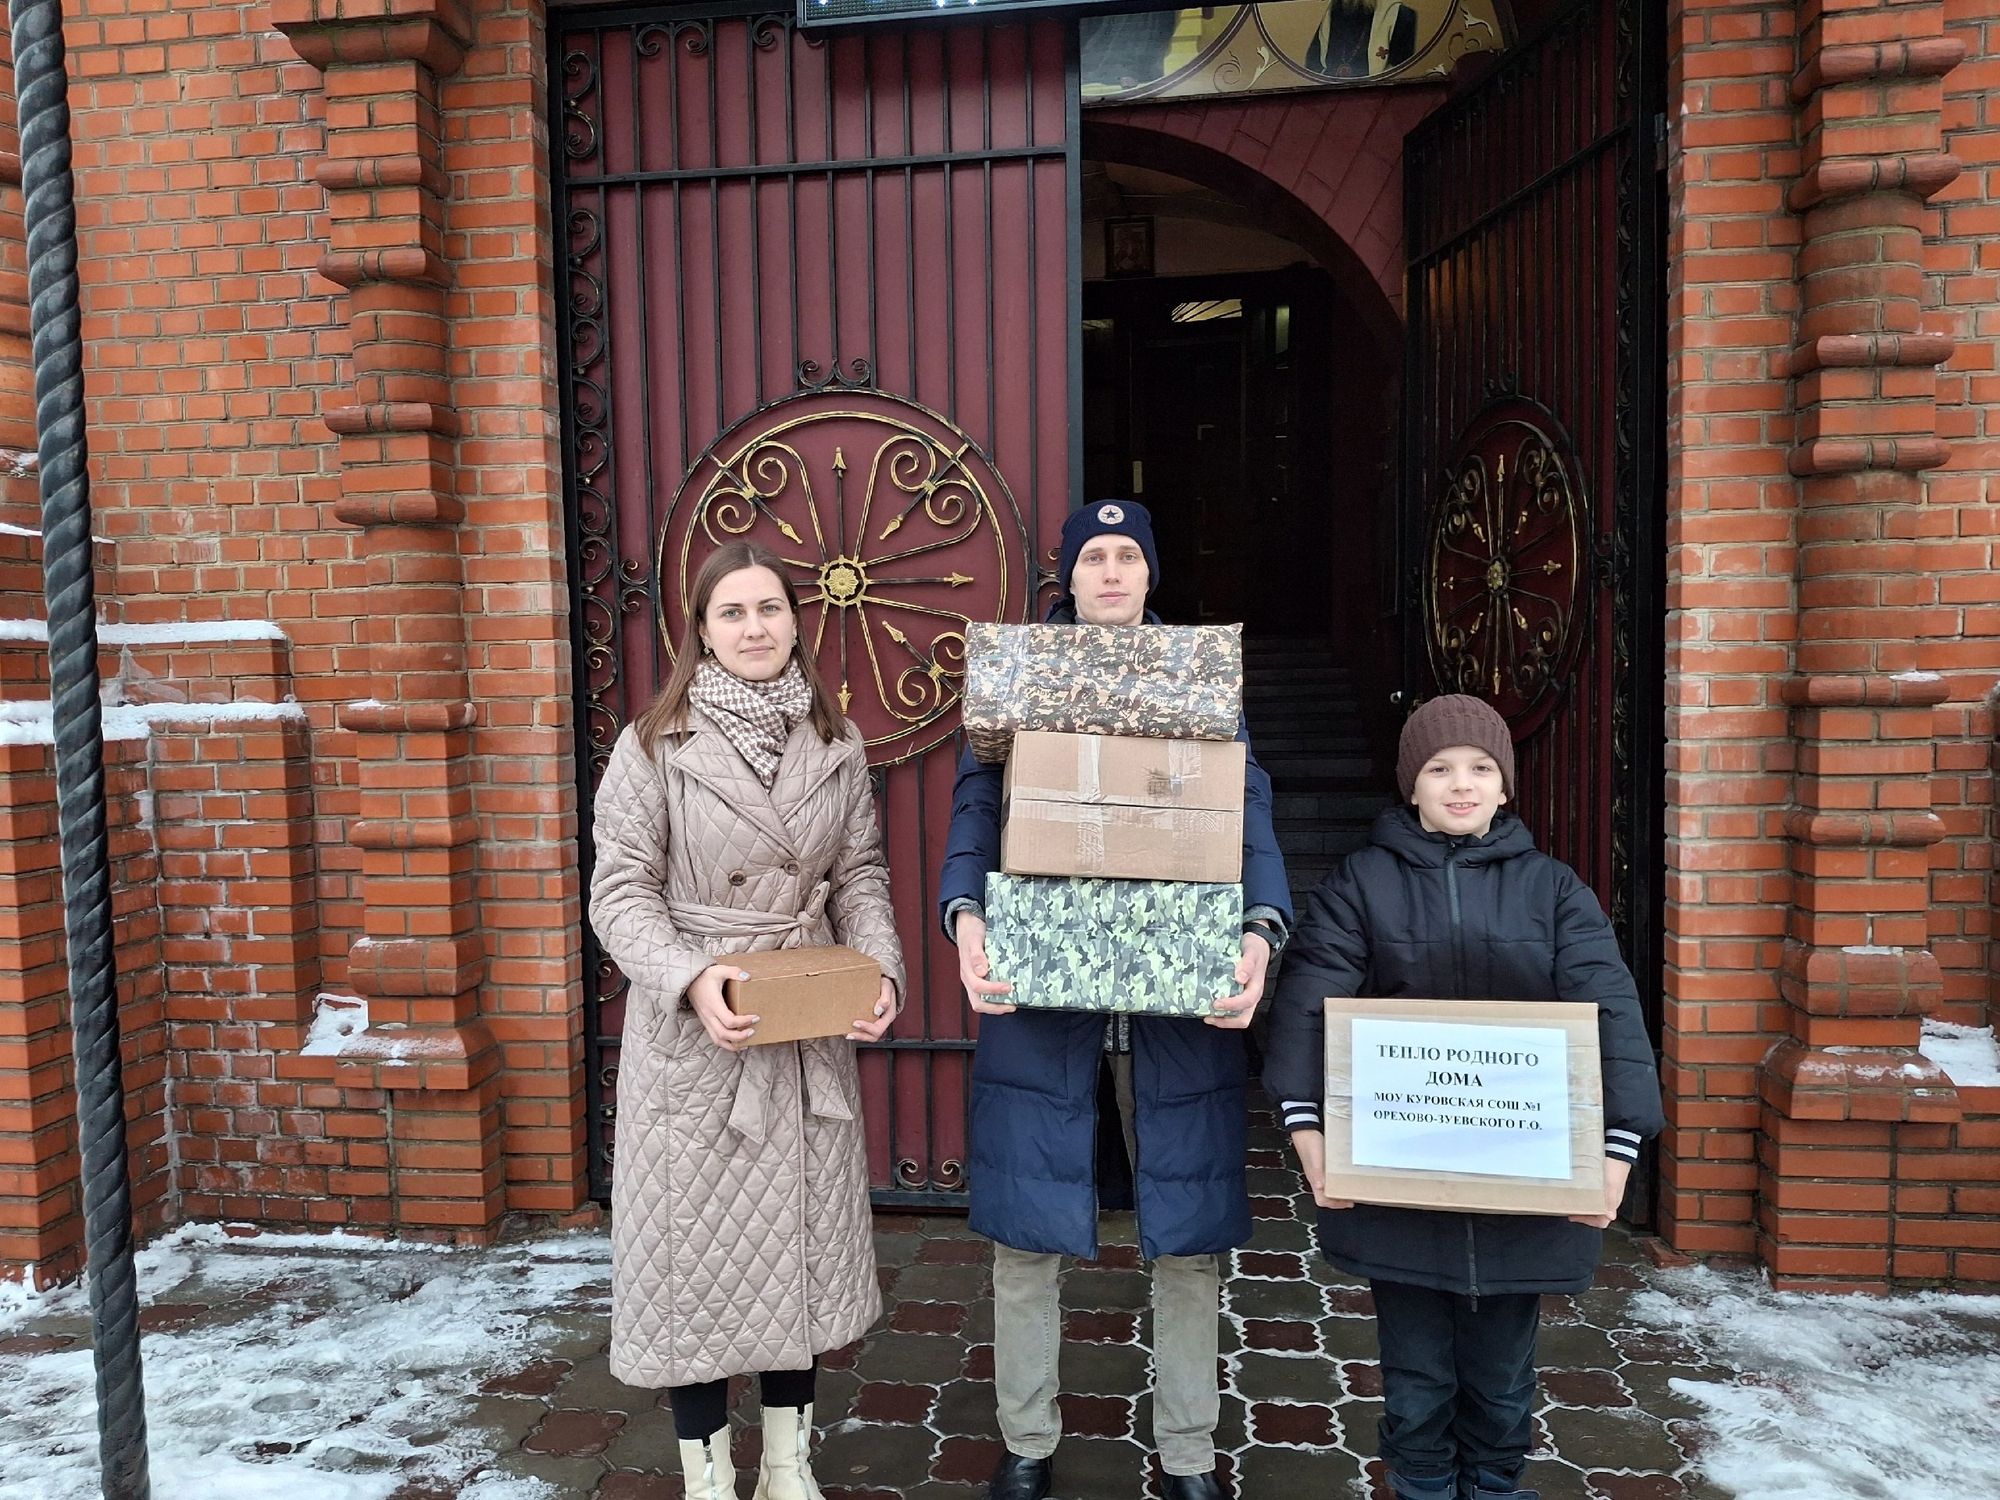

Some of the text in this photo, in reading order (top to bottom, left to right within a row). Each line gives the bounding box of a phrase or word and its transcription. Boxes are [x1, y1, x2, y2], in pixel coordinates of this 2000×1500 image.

[1376, 1044, 1539, 1067] ТЕПЛО РОДНОГО
[1425, 1071, 1483, 1087] ДОМА
[1374, 1092, 1541, 1112] МОУ КУРОВСКАЯ СОШ №1
[1373, 1110, 1543, 1130] ОРЕХОВО-ЗУЕВСКОГО Г.О.
